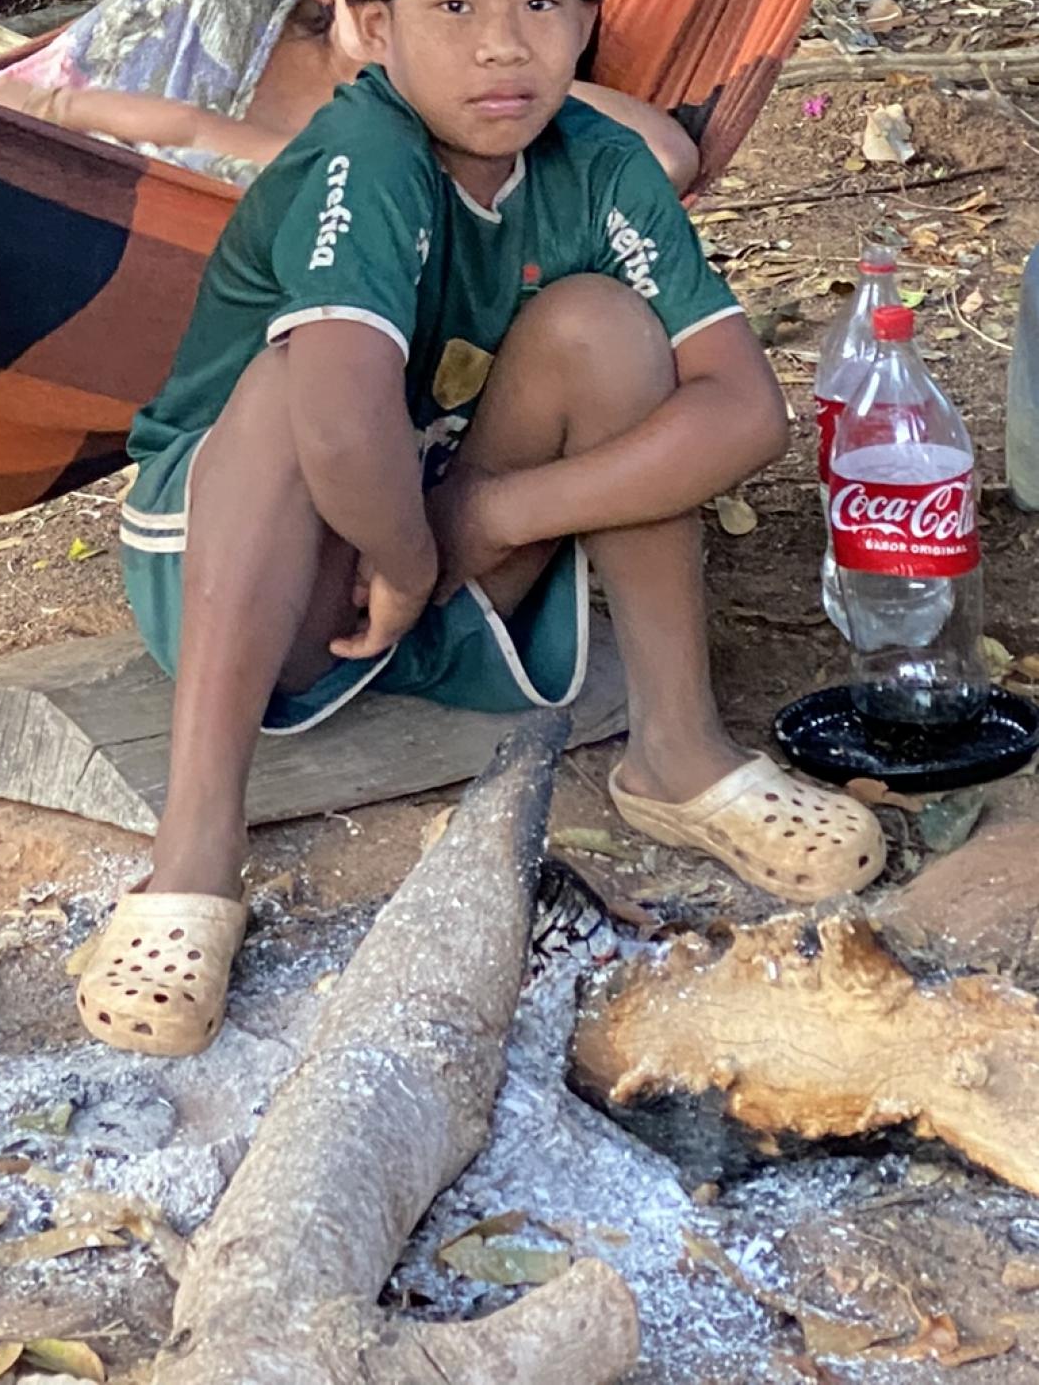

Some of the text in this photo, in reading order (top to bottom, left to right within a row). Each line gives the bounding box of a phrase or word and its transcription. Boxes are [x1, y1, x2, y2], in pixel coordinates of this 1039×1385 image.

[308, 155, 352, 271] crefisa
[831, 482, 975, 540] Coca-Cola
[865, 538, 967, 556] SABOR ORIGINAL
